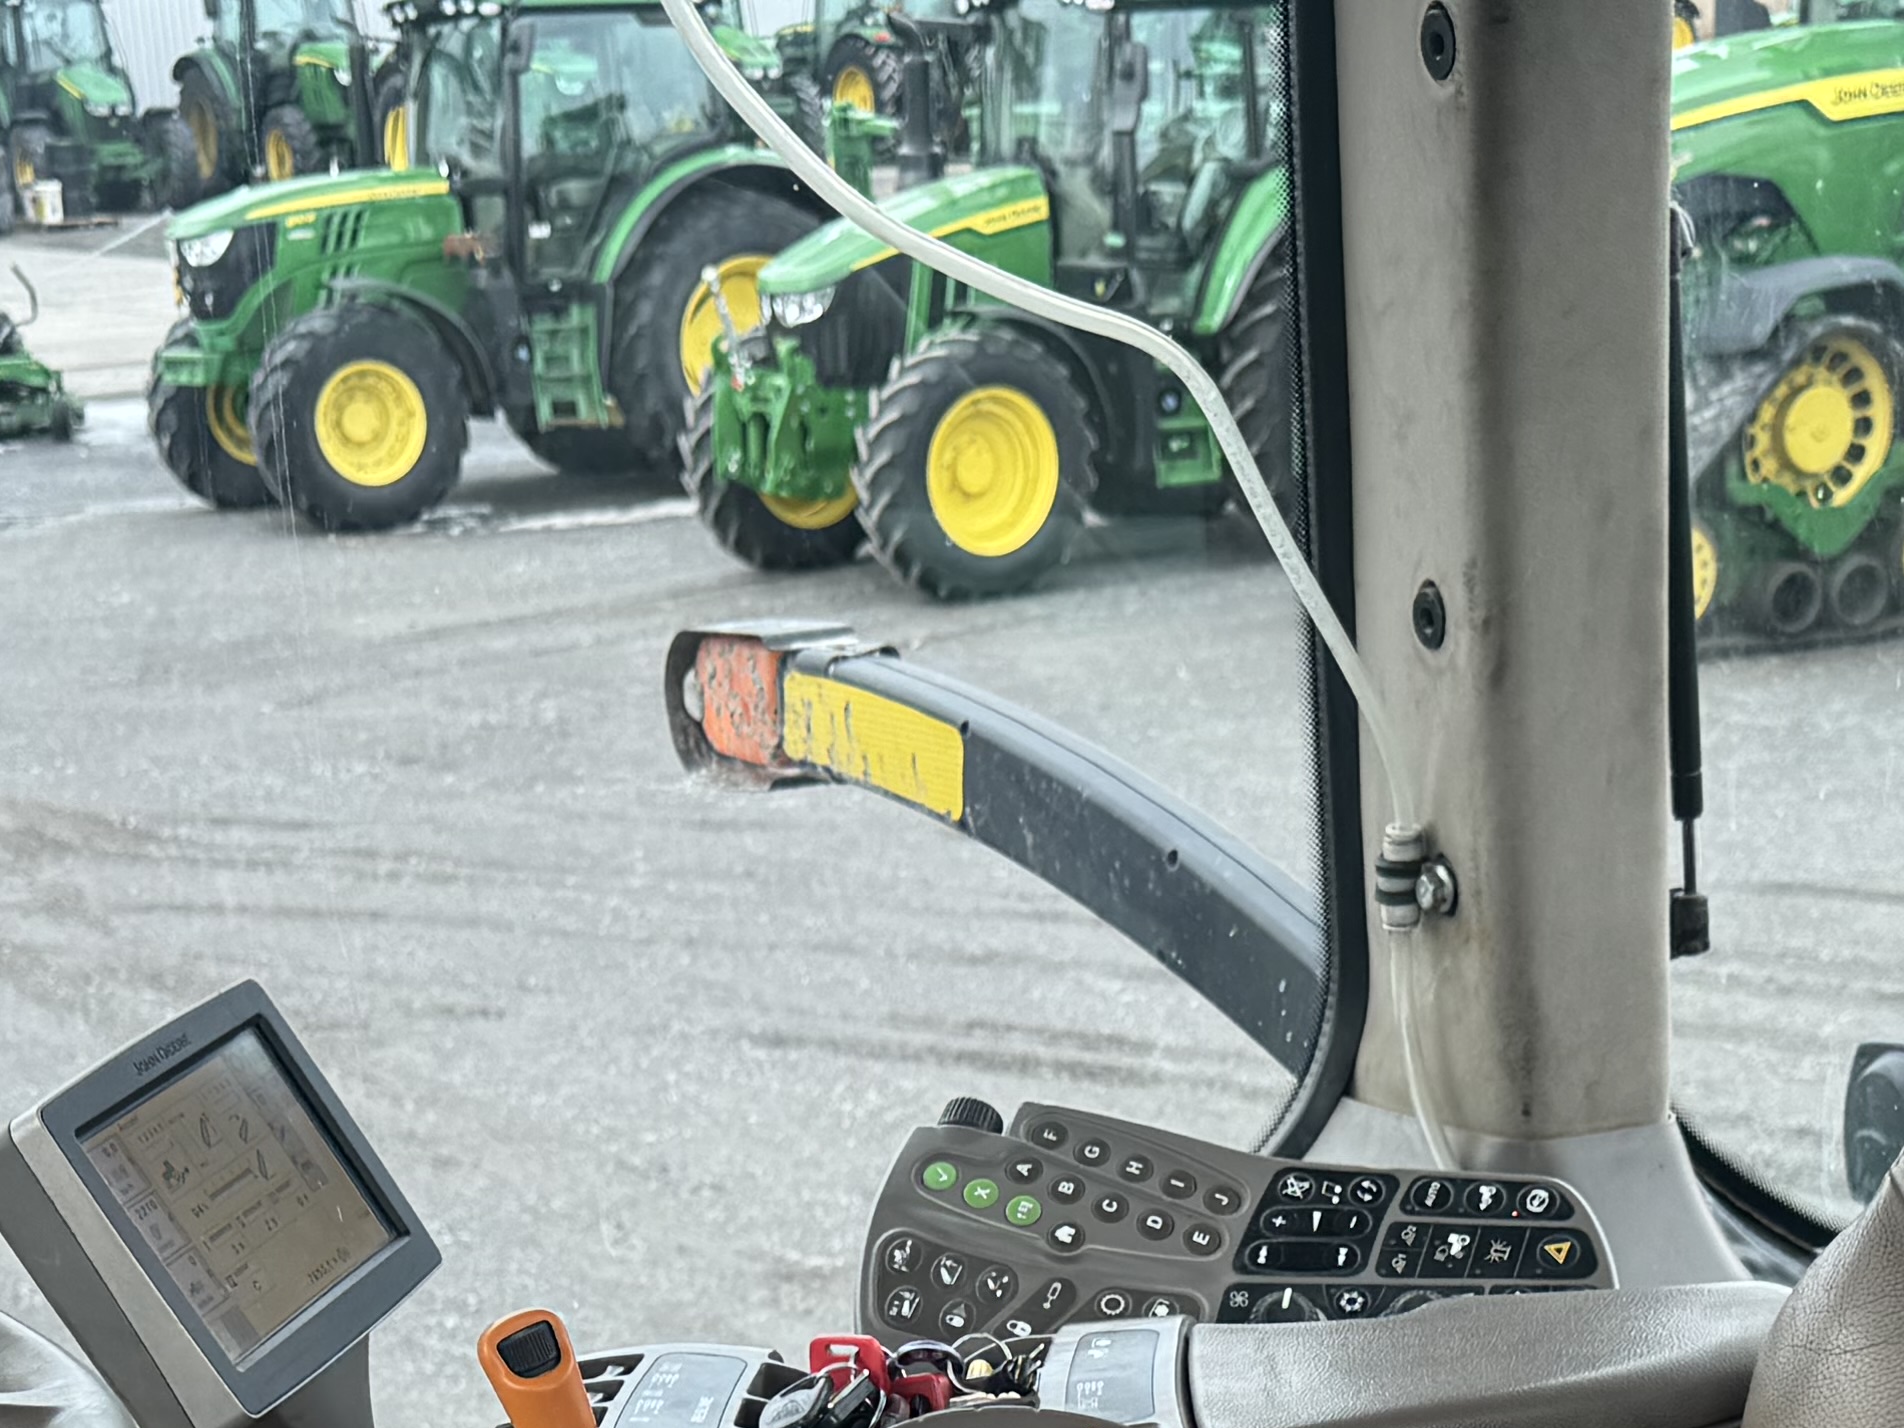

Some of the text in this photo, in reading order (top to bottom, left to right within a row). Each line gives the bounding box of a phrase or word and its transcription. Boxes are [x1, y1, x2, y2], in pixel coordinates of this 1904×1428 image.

[1043, 1128, 1058, 1142] F
[1083, 1145, 1101, 1159] G
[1015, 1162, 1033, 1177] A
[1125, 1161, 1144, 1175] H
[1057, 1180, 1076, 1196] B
[1424, 1181, 1442, 1207] AUTO
[1101, 1198, 1119, 1213] C
[1214, 1192, 1230, 1207] J
[1146, 1215, 1163, 1230] D
[1192, 1231, 1211, 1246] E
